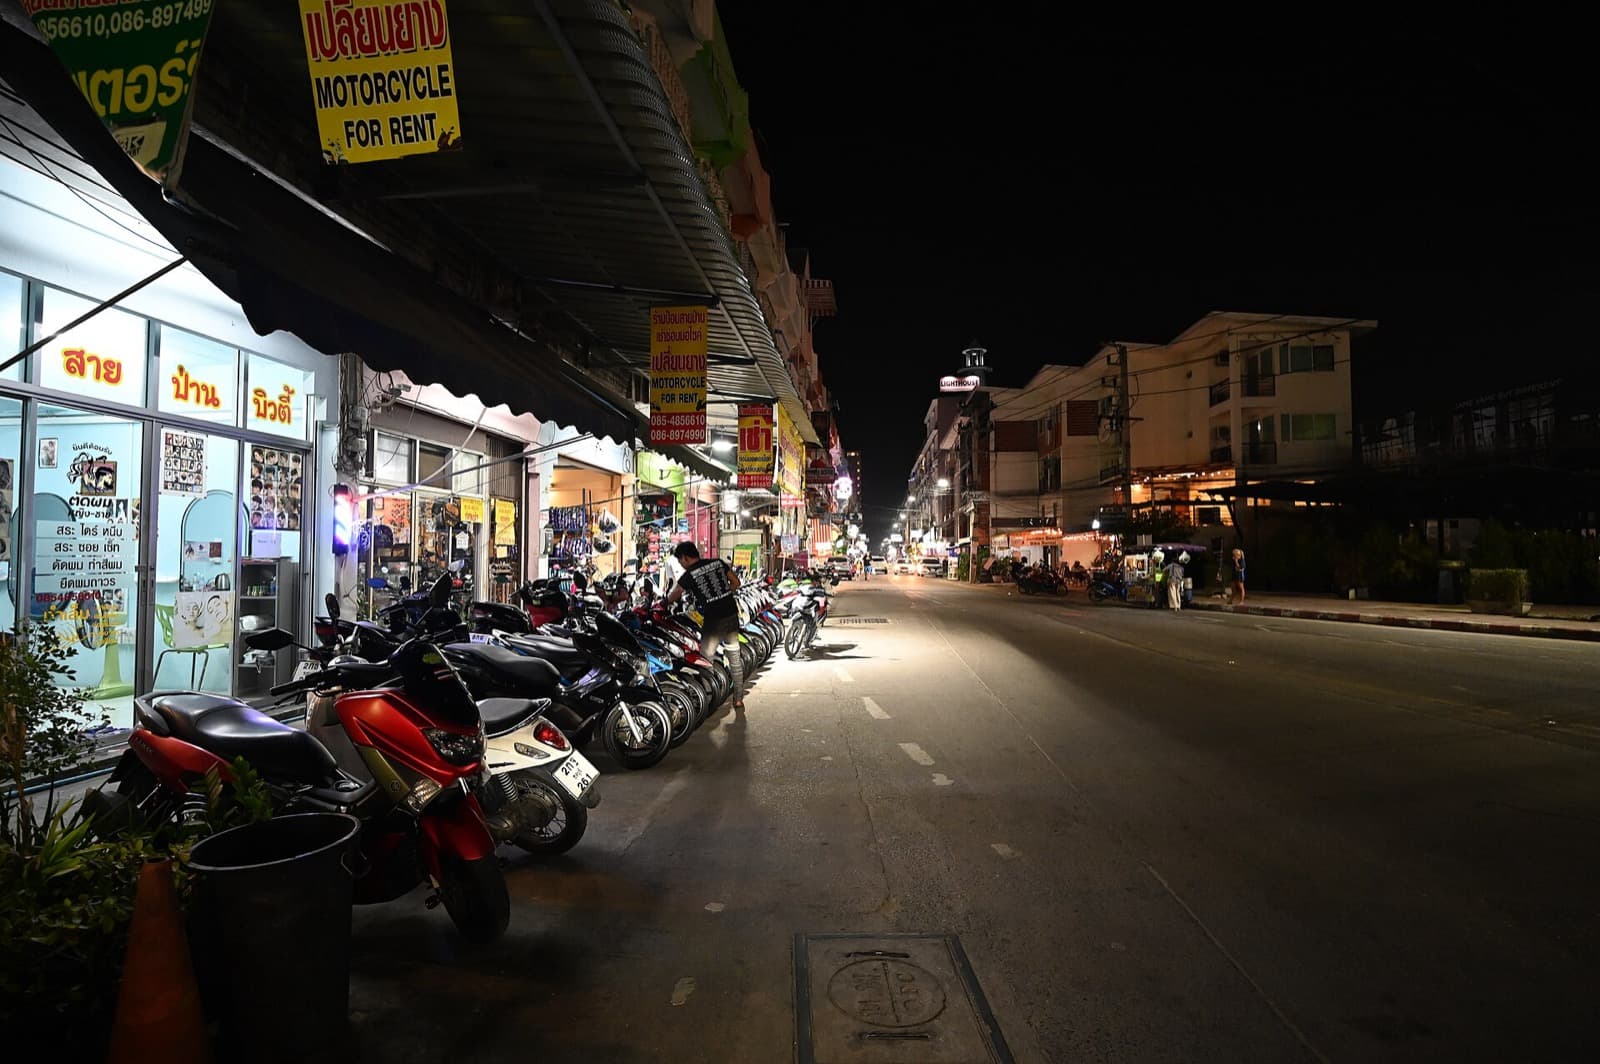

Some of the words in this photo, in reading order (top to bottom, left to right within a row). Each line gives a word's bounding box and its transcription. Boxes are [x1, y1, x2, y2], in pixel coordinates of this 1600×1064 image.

[315, 64, 452, 109] MOTORCYCLE
[343, 118, 384, 148] FOR
[389, 112, 438, 145] RENT
[652, 345, 706, 371] เปลี่ยนยาง
[63, 349, 122, 385] สาย
[172, 365, 220, 409] ป่าน
[253, 384, 295, 424] บิวตี้
[652, 376, 705, 389] MOTORCYCLE
[661, 393, 676, 404] FOR
[678, 393, 698, 404] RENT
[651, 415, 705, 426] 085-4856610
[651, 429, 705, 440] 086-8974990
[739, 420, 772, 452] เช่า
[69, 491, 112, 508] ตัดผม
[56, 525, 76, 536] สระ
[80, 523, 98, 537] ไดร์
[102, 525, 123, 537] หนีบ
[54, 542, 73, 553] สระ
[79, 543, 98, 553] ซอย
[89, 559, 122, 570] ทำสีผม
